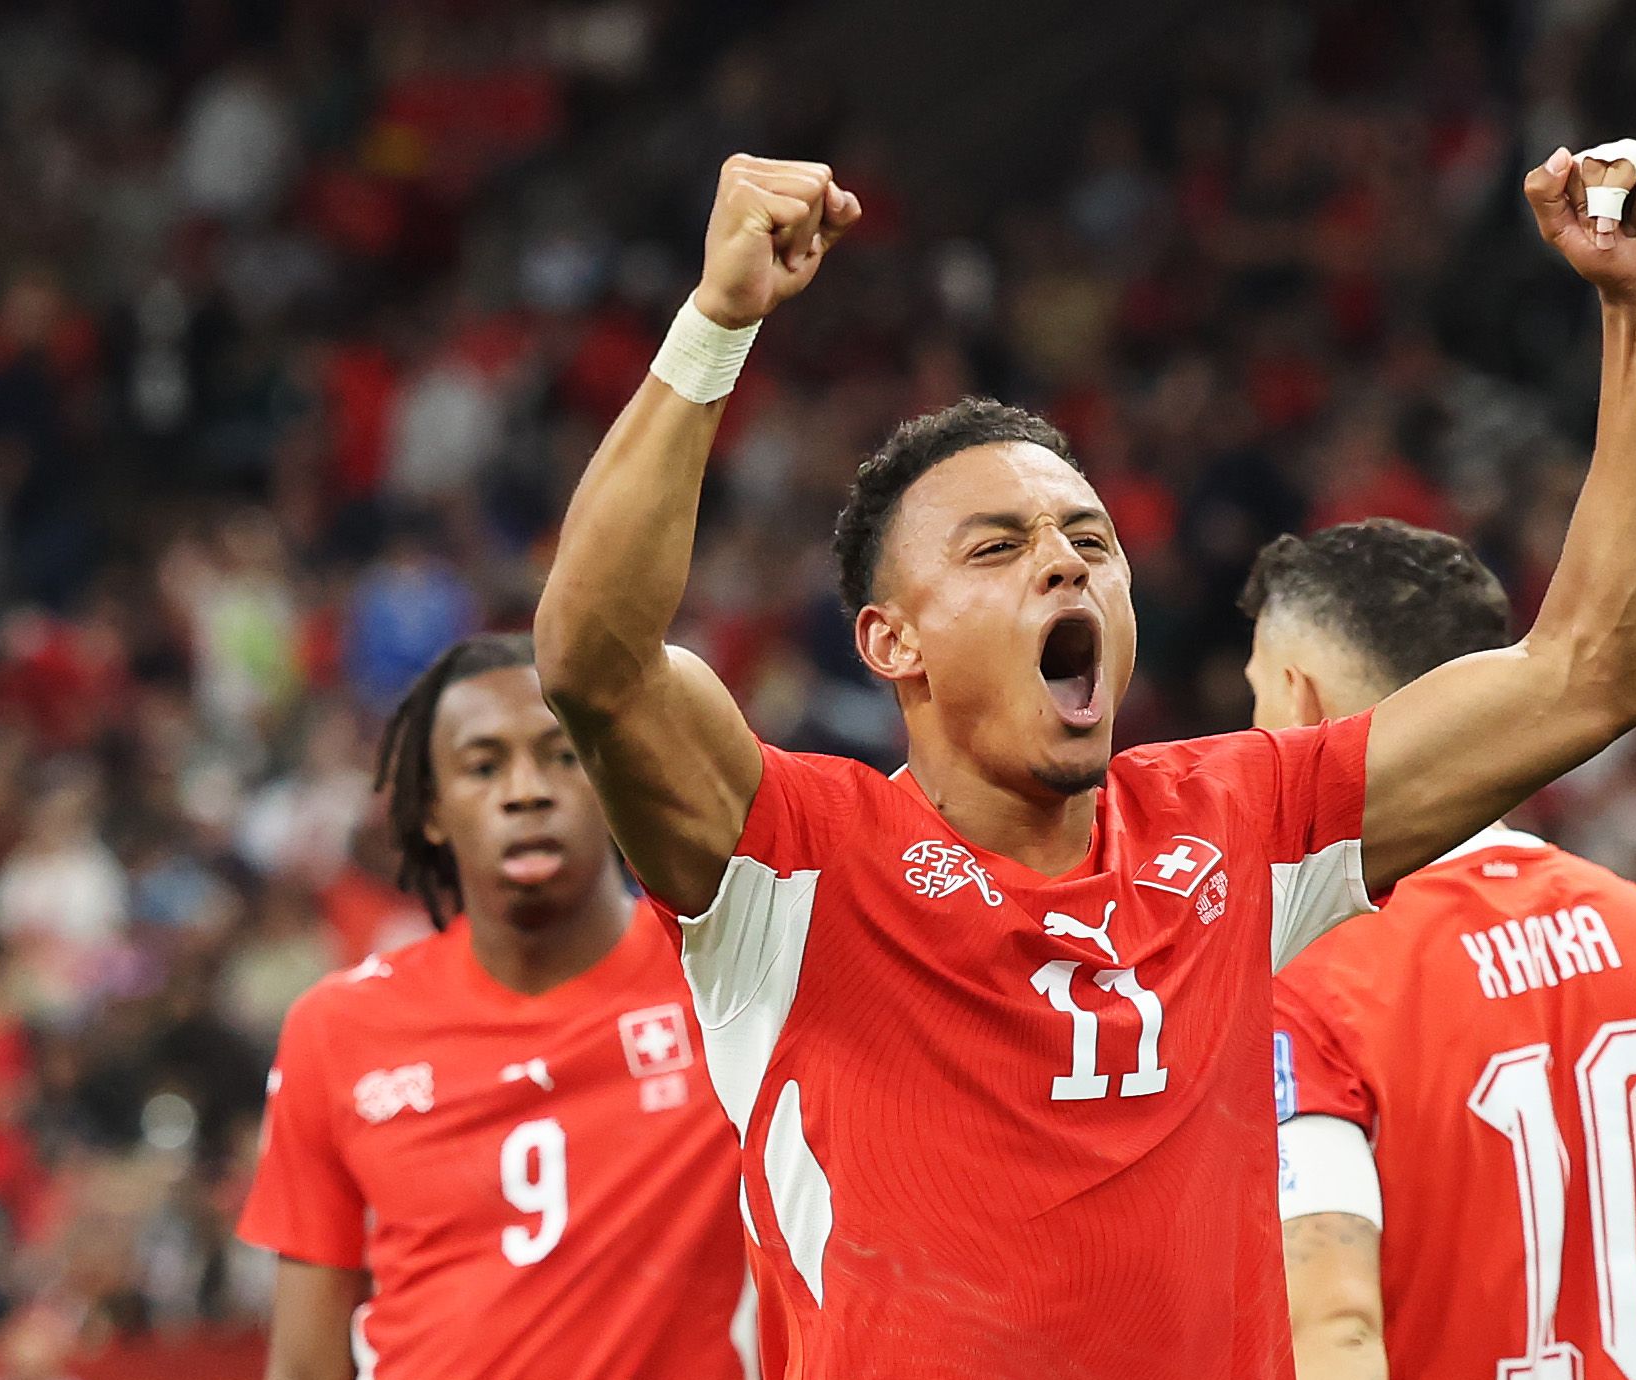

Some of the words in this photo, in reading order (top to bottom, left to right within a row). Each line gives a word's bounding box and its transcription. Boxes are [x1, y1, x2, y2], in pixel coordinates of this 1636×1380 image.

[1460, 904, 1623, 999] XHAKA
[1030, 961, 1168, 1100] 11
[500, 1117, 568, 1267] 9
